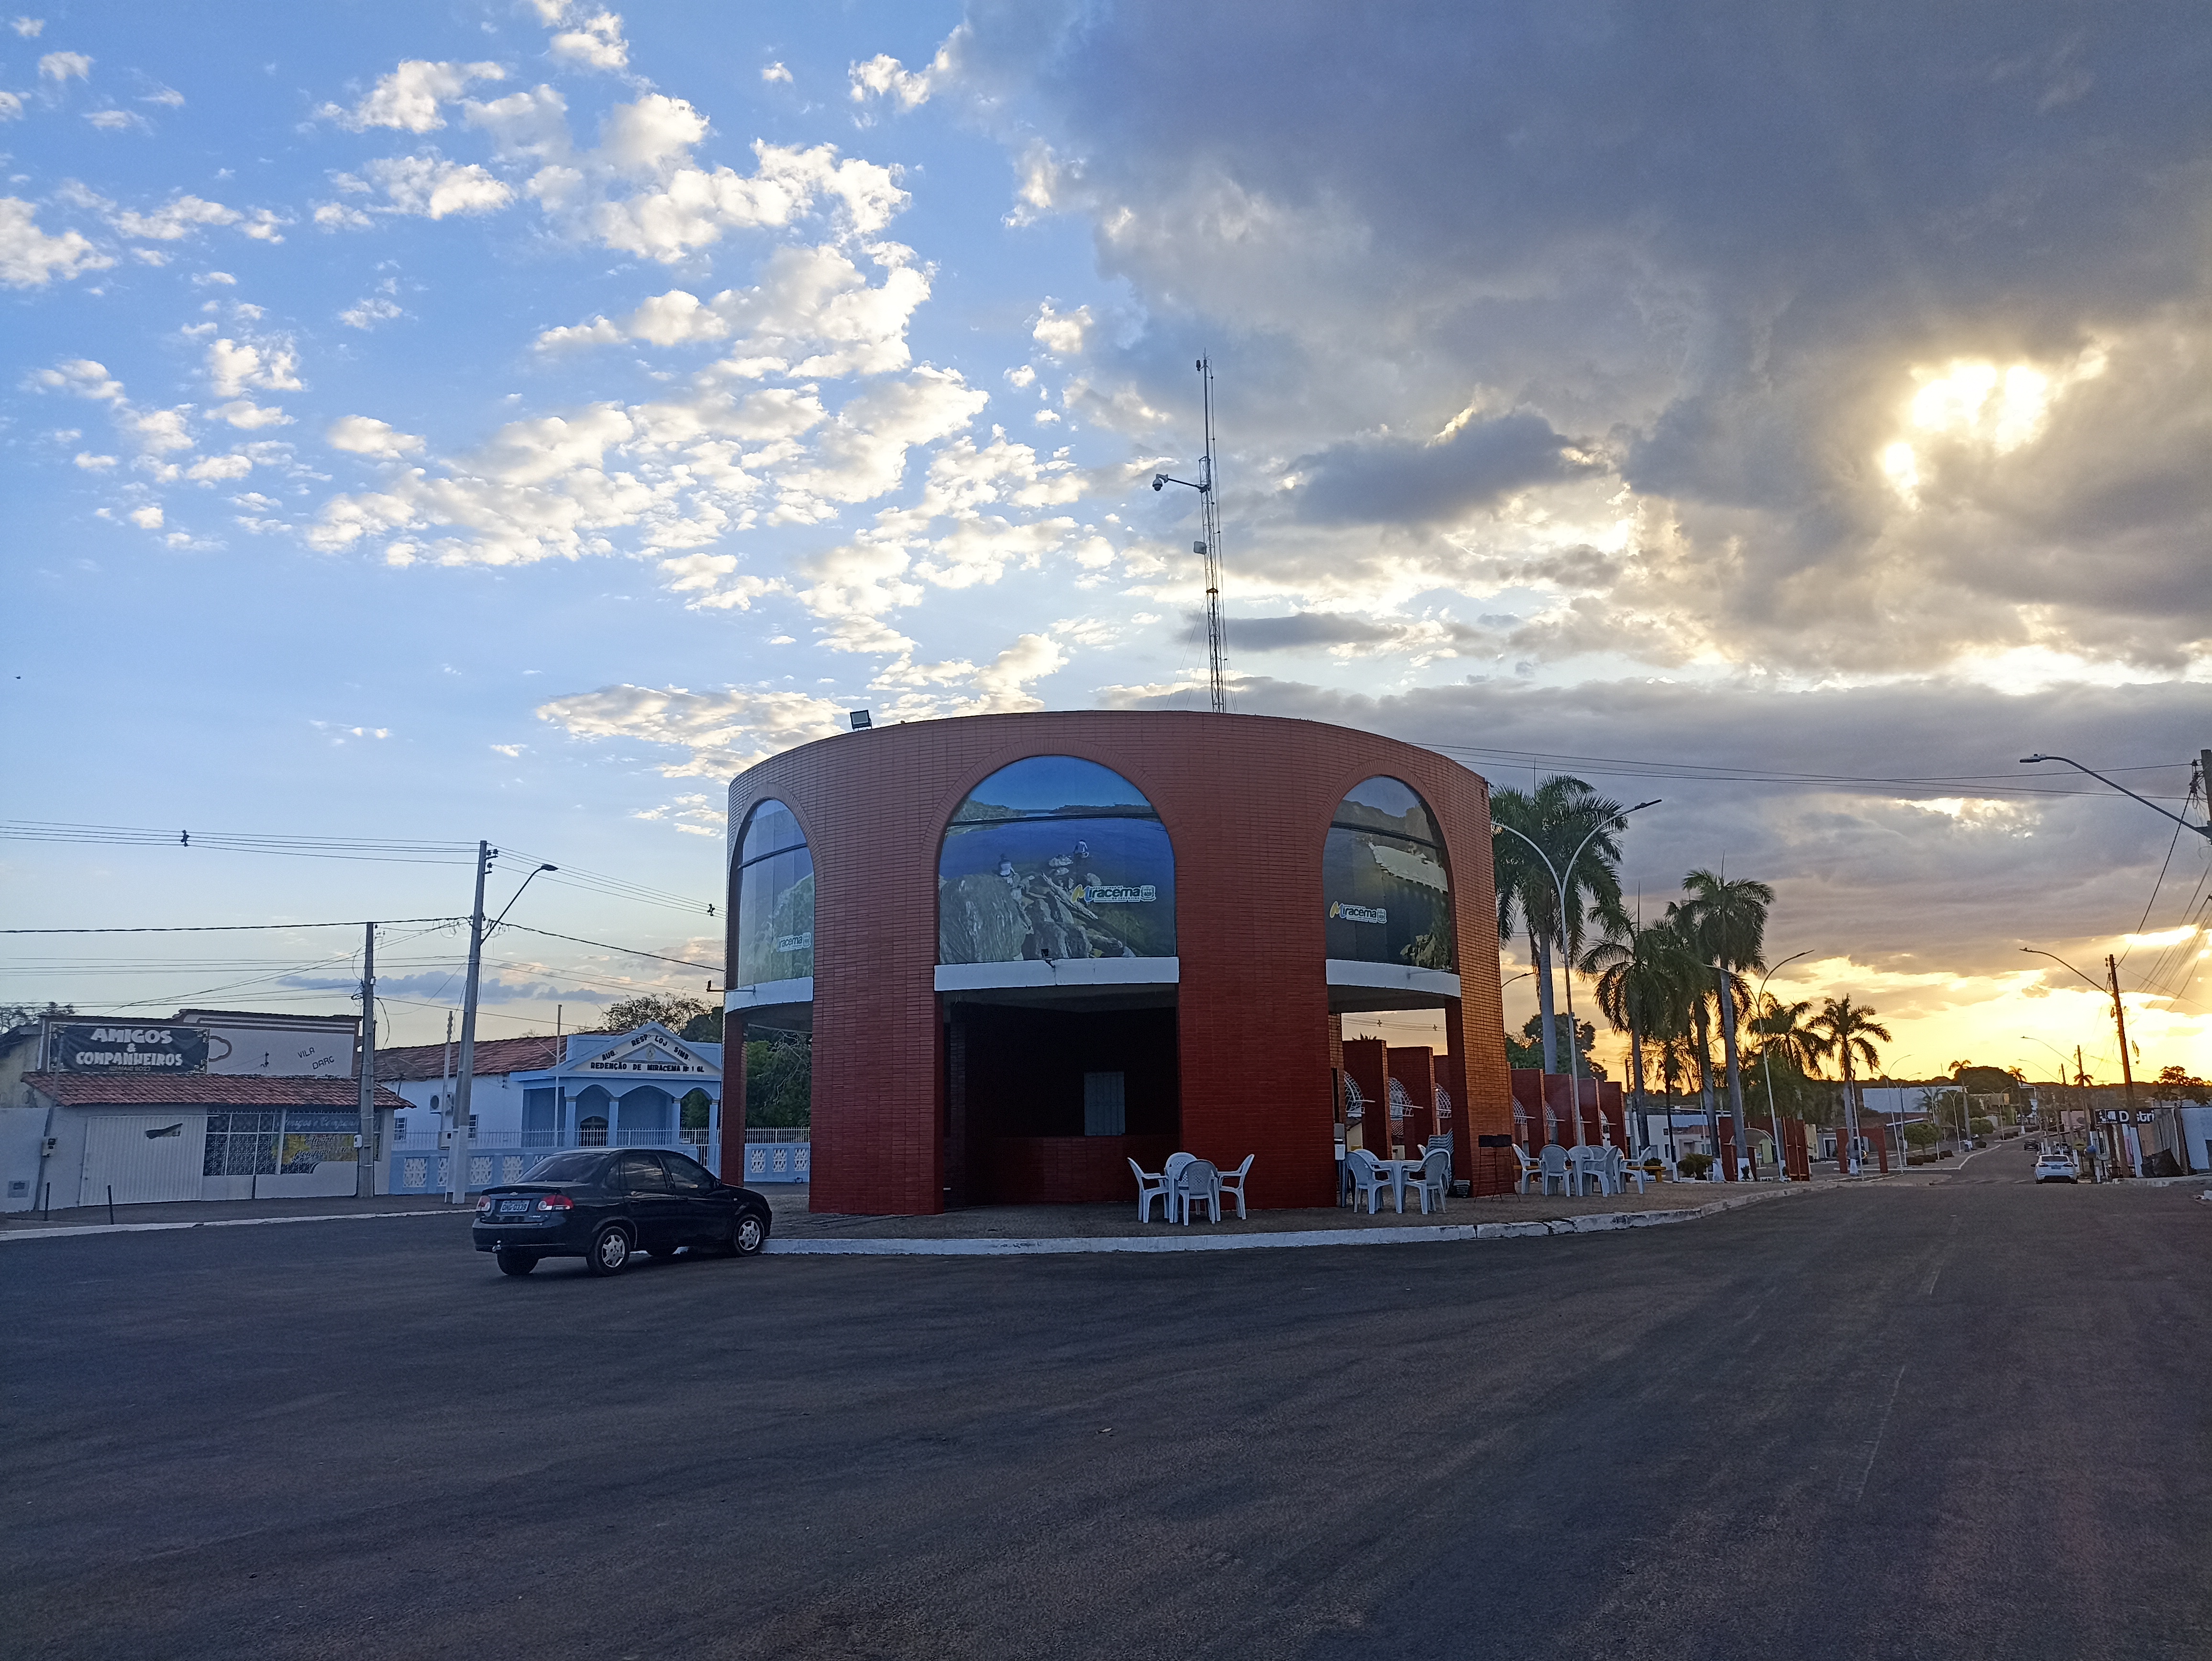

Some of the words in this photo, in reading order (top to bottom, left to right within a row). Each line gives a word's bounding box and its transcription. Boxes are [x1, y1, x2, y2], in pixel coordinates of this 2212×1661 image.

[1072, 885, 1140, 902] Miracema
[1330, 901, 1376, 918] Miracema
[90, 1028, 172, 1044] AMIGOS
[127, 1043, 136, 1052] &
[298, 1047, 315, 1058] VILA
[76, 1052, 183, 1066] COMPANHEIROS
[312, 1056, 334, 1069] DARC
[591, 1062, 627, 1070] REDENÇÃO
[2119, 1110, 2154, 1122] Dstri
